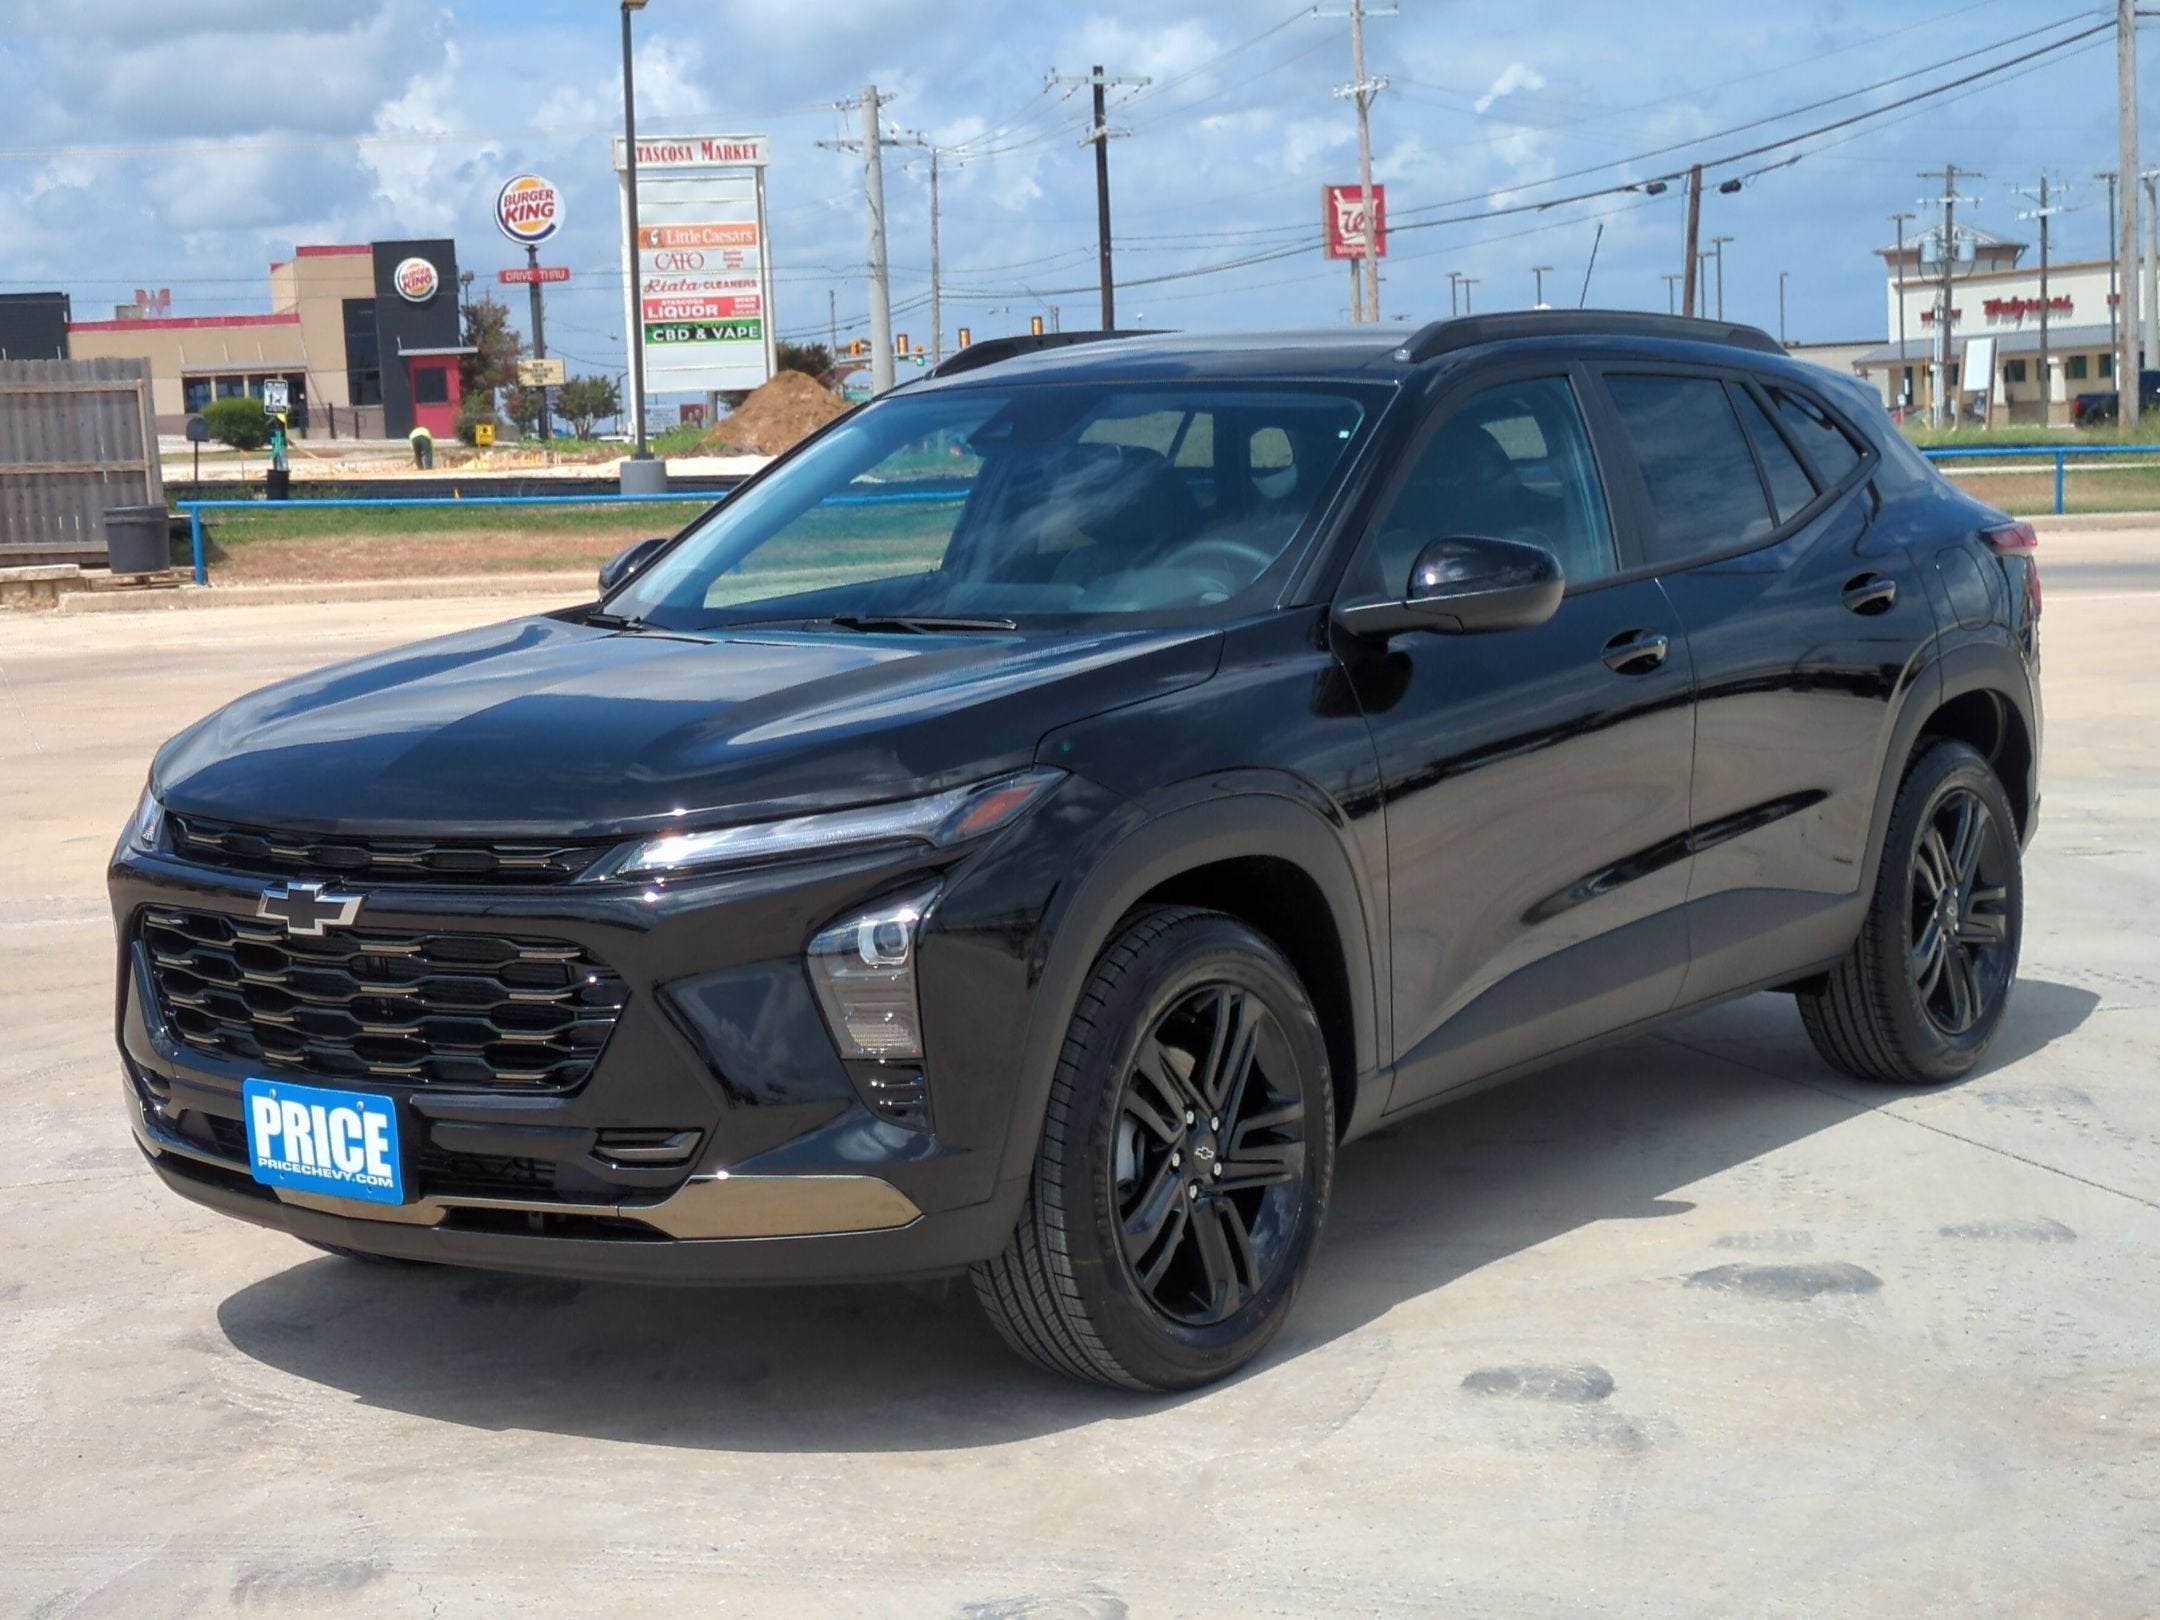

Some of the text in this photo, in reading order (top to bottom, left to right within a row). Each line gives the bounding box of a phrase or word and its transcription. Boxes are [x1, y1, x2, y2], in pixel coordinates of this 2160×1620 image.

[635, 141, 758, 162] TASCOSA MARKET
[504, 189, 554, 208] BURGER
[504, 202, 555, 224] KING
[666, 228, 753, 245] Little Caesars
[655, 252, 704, 270] CATO
[505, 270, 565, 282] DRIVE THRU
[644, 278, 757, 293] Riata CLEANERS
[647, 304, 718, 318] LIQUOR
[653, 326, 758, 341] CBD & VAPE
[251, 1095, 392, 1178] PRICE
[258, 1158, 393, 1188] PRICECHEVY.COM
